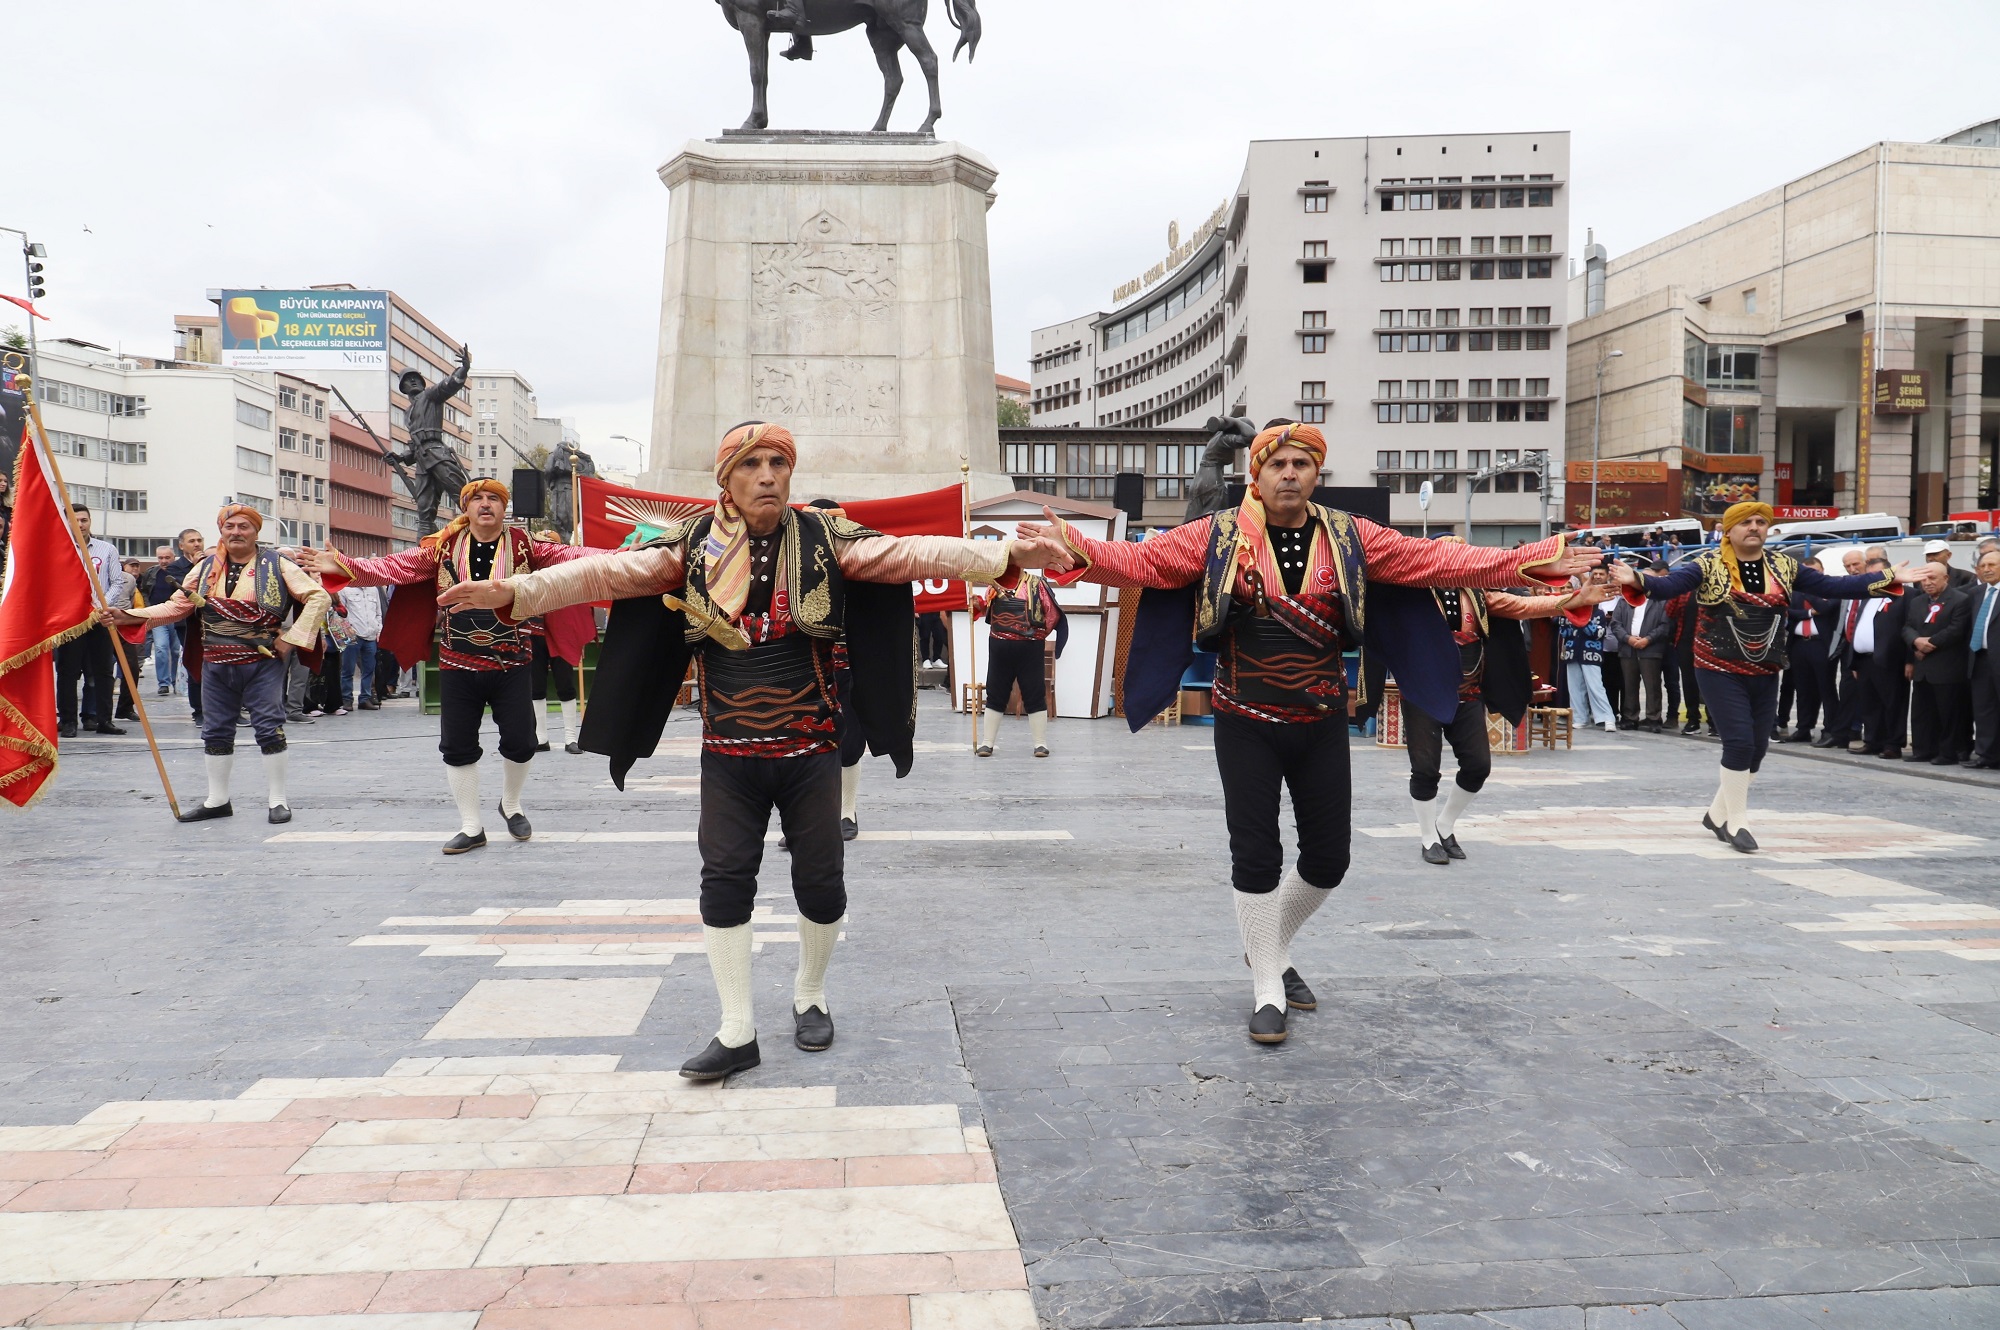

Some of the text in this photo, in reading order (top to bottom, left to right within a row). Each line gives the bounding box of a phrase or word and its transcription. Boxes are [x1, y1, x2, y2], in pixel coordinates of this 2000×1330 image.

[1113, 277, 1141, 303] ANKARA
[279, 297, 386, 310] BÜYÜK KAMPANYA
[343, 312, 366, 320] GEÇERLİ
[284, 321, 378, 337] 18 AY TAKSİT
[281, 339, 383, 348] SEÇENEKLERİ SİZİ BEKLİYOR!
[342, 352, 383, 364] Niens
[1862, 338, 1870, 379] ULUS
[1901, 374, 1921, 384] ULUS
[1899, 385, 1922, 397] ŞEHİR
[1895, 398, 1926, 409] ÇARŞISI
[1782, 508, 1829, 518] 7. NOTER
